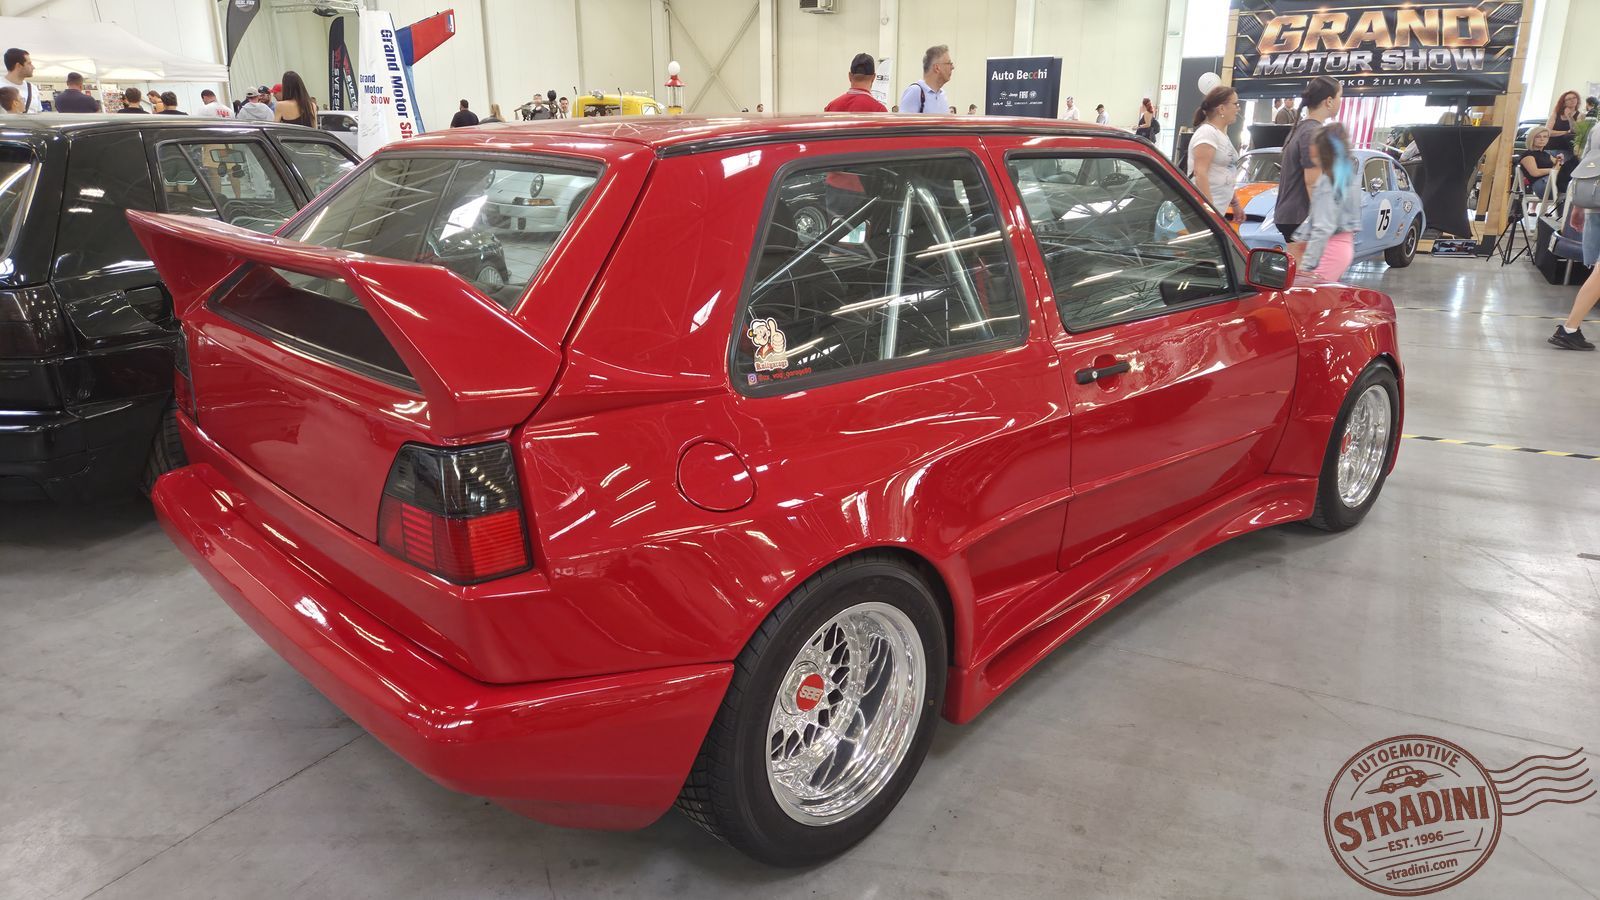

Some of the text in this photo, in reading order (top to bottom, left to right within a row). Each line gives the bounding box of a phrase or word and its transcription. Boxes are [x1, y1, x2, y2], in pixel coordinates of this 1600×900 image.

[1256, 8, 1491, 54] GRAND
[1253, 48, 1485, 76] MOTOR SHOW
[359, 74, 376, 83] Grand
[991, 68, 1048, 80] Auto Becchi
[380, 29, 414, 139] Grand Motor Sh
[1372, 77, 1422, 86] ŽILINA
[364, 85, 383, 94] Motor
[370, 95, 390, 104] Show
[1377, 209, 1391, 231] 75
